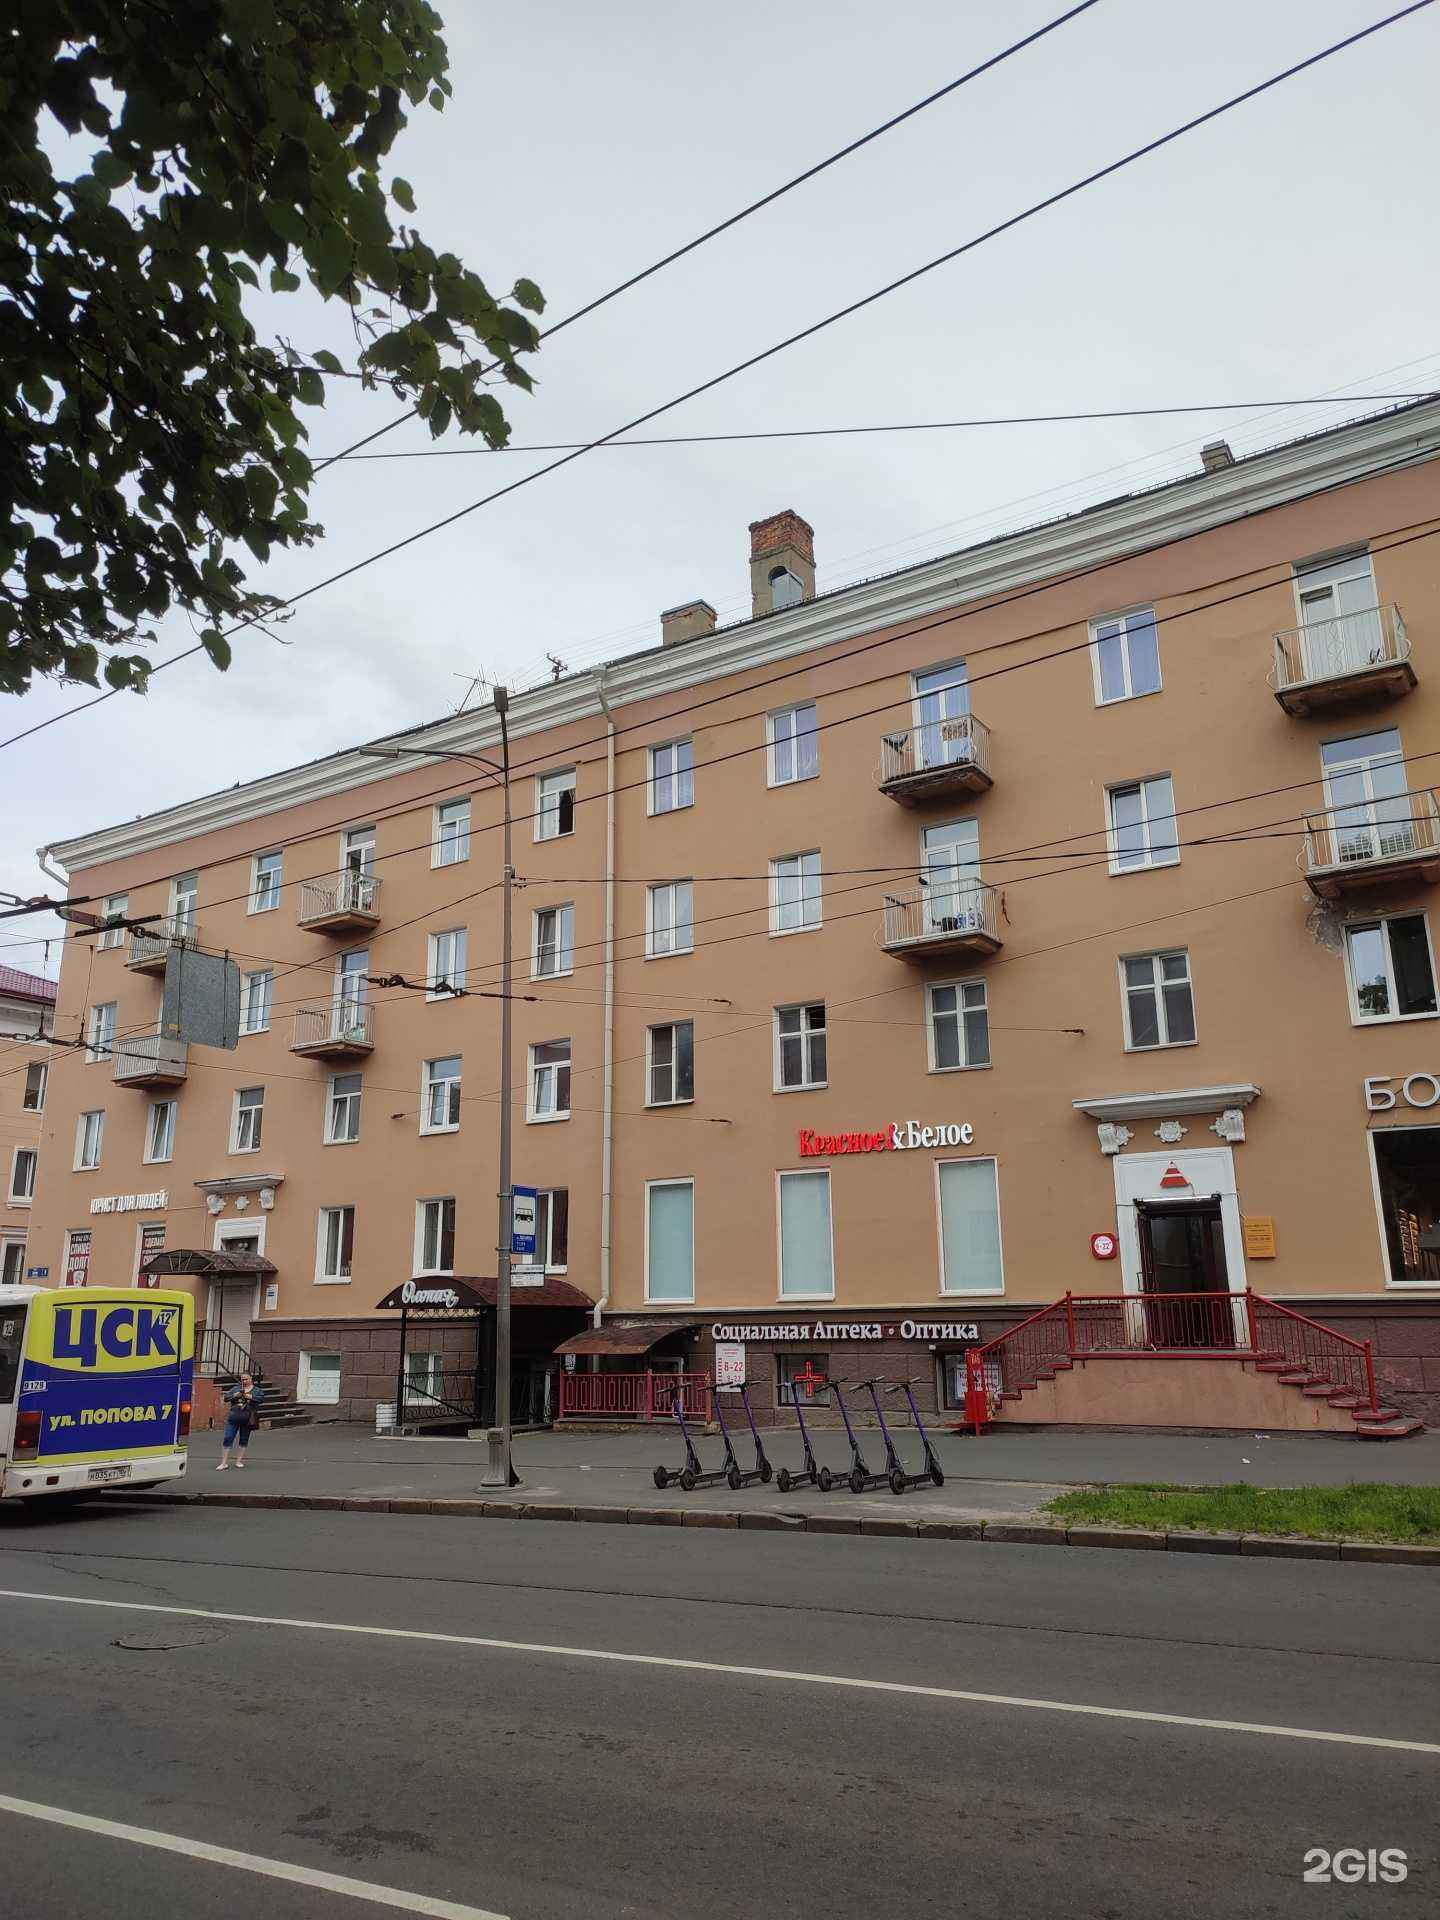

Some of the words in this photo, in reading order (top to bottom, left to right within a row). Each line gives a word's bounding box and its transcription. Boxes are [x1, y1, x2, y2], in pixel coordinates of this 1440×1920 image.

[90, 1196, 117, 1214] ЮРИСТ
[117, 1194, 136, 1213] ДЛЯ
[160, 1312, 171, 1325] 12
[52, 1308, 177, 1367] ЦСК
[711, 1322, 809, 1343] Социальная
[813, 1320, 882, 1340] Аптека
[900, 1320, 978, 1340] Оптика
[49, 1415, 76, 1431] ул.
[80, 1405, 157, 1425] ПОПОВА
[161, 1404, 173, 1420] 7
